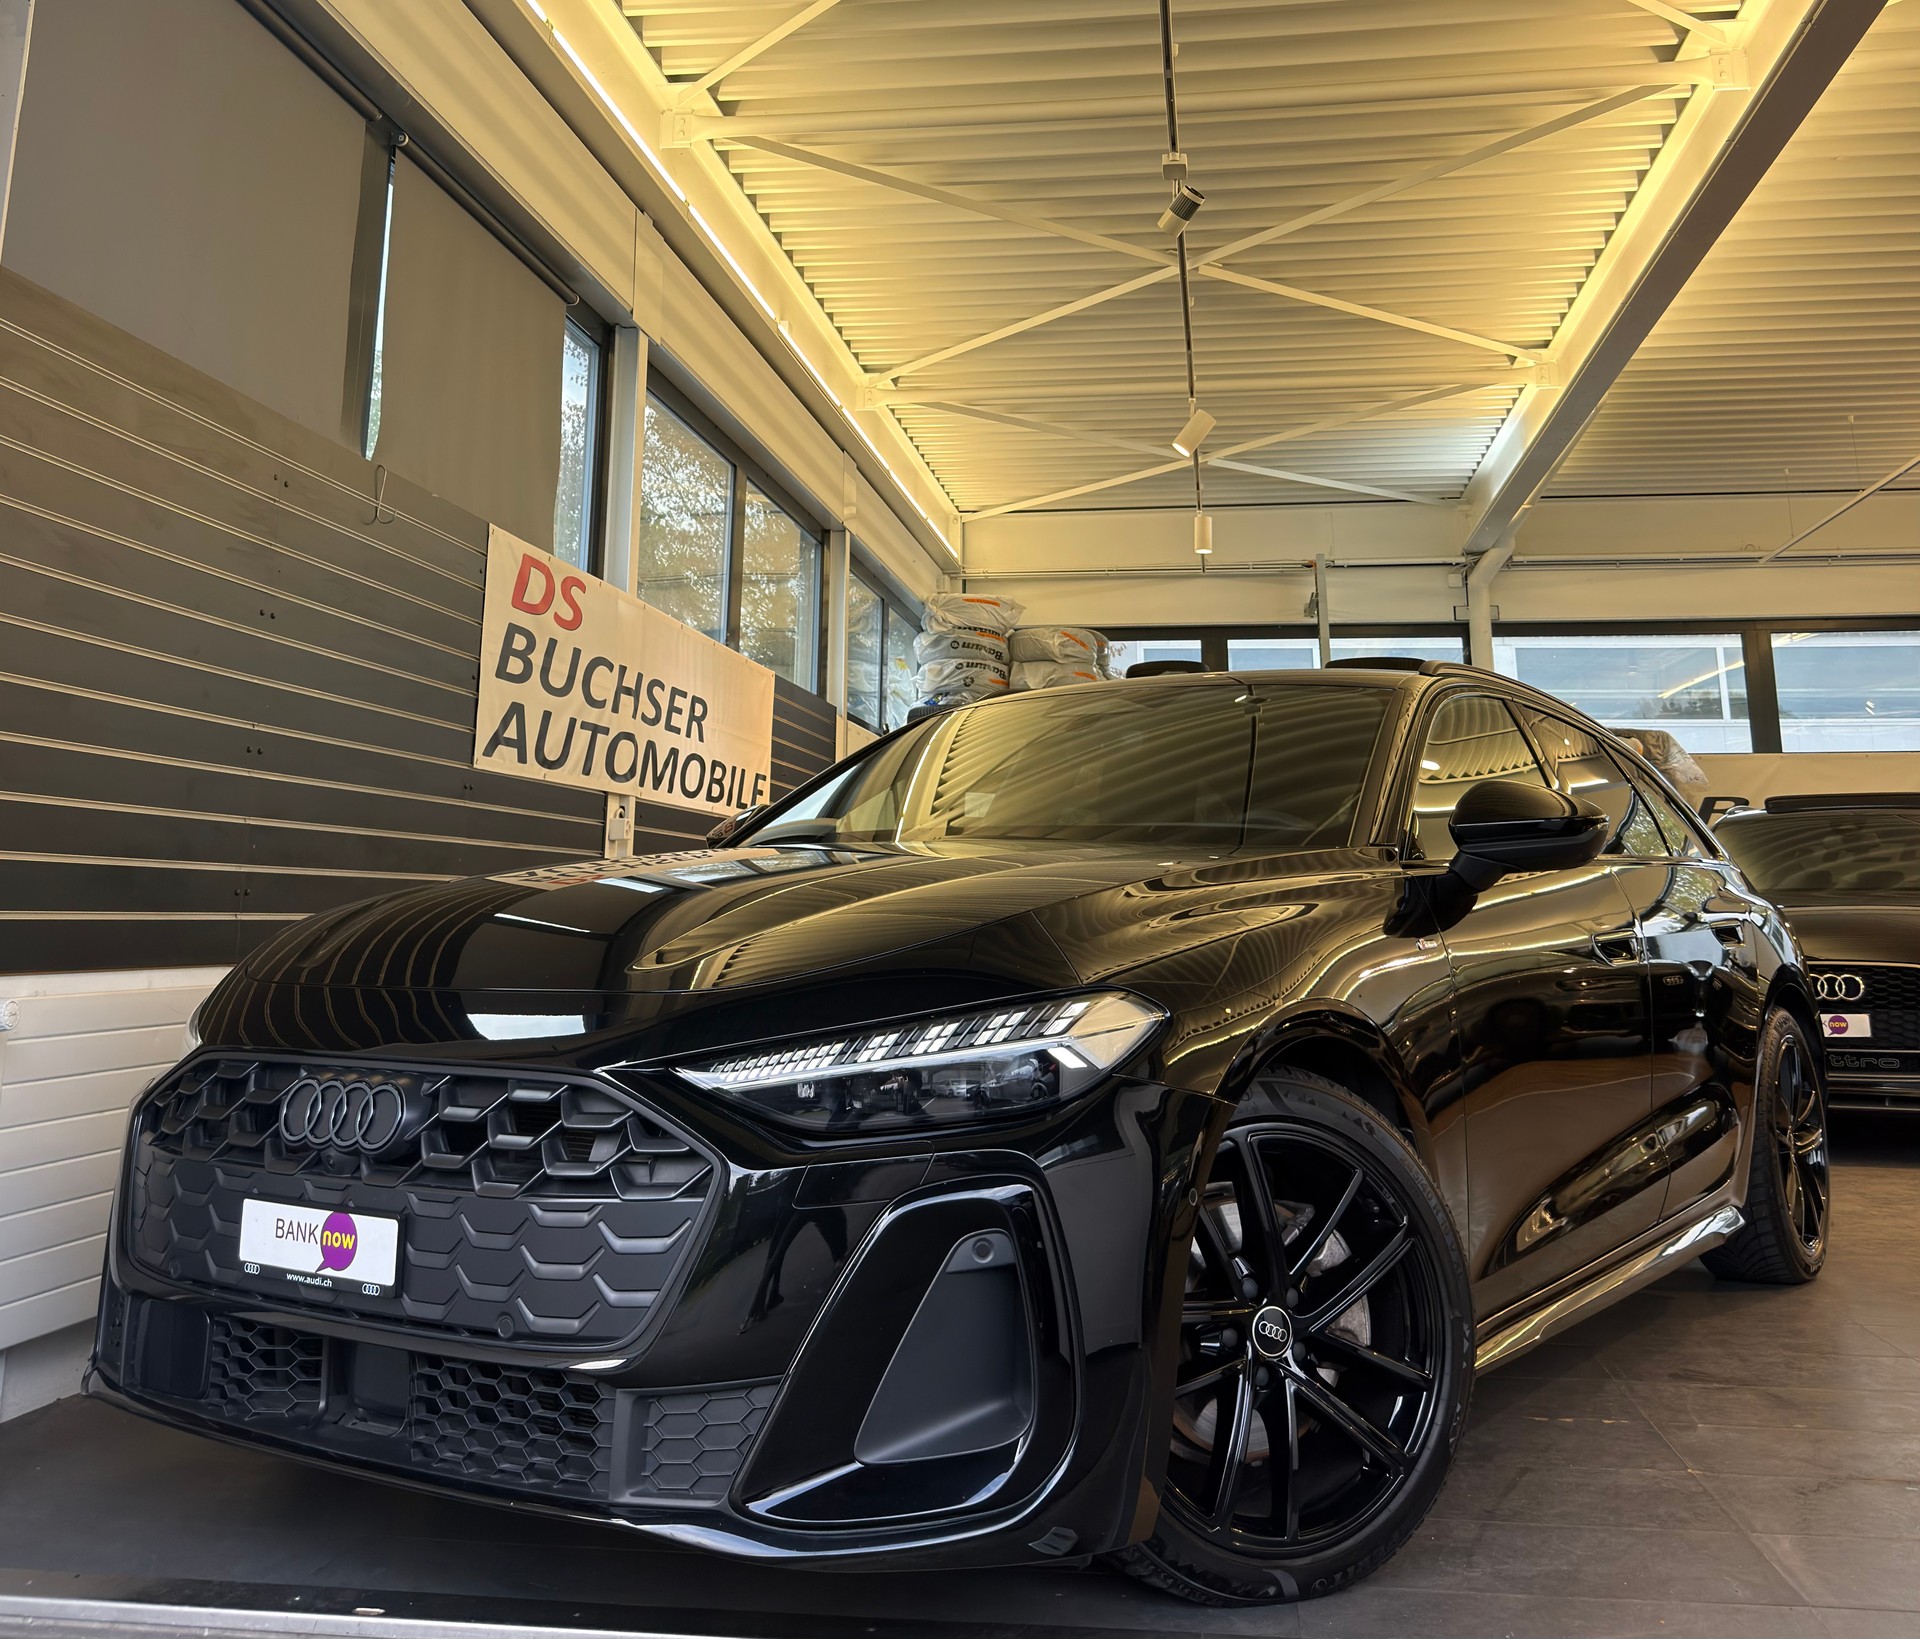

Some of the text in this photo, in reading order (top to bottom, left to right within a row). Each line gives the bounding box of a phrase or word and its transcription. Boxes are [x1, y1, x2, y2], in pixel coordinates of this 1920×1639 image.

[511, 553, 586, 631] DS
[494, 622, 708, 743] BUCHSER
[482, 701, 767, 810] AUTOMOBILE
[1829, 1021, 1848, 1029] now
[1828, 1054, 1901, 1069] ttro
[275, 1217, 356, 1250] BANK now
[286, 1273, 333, 1288] www.audi.ch
